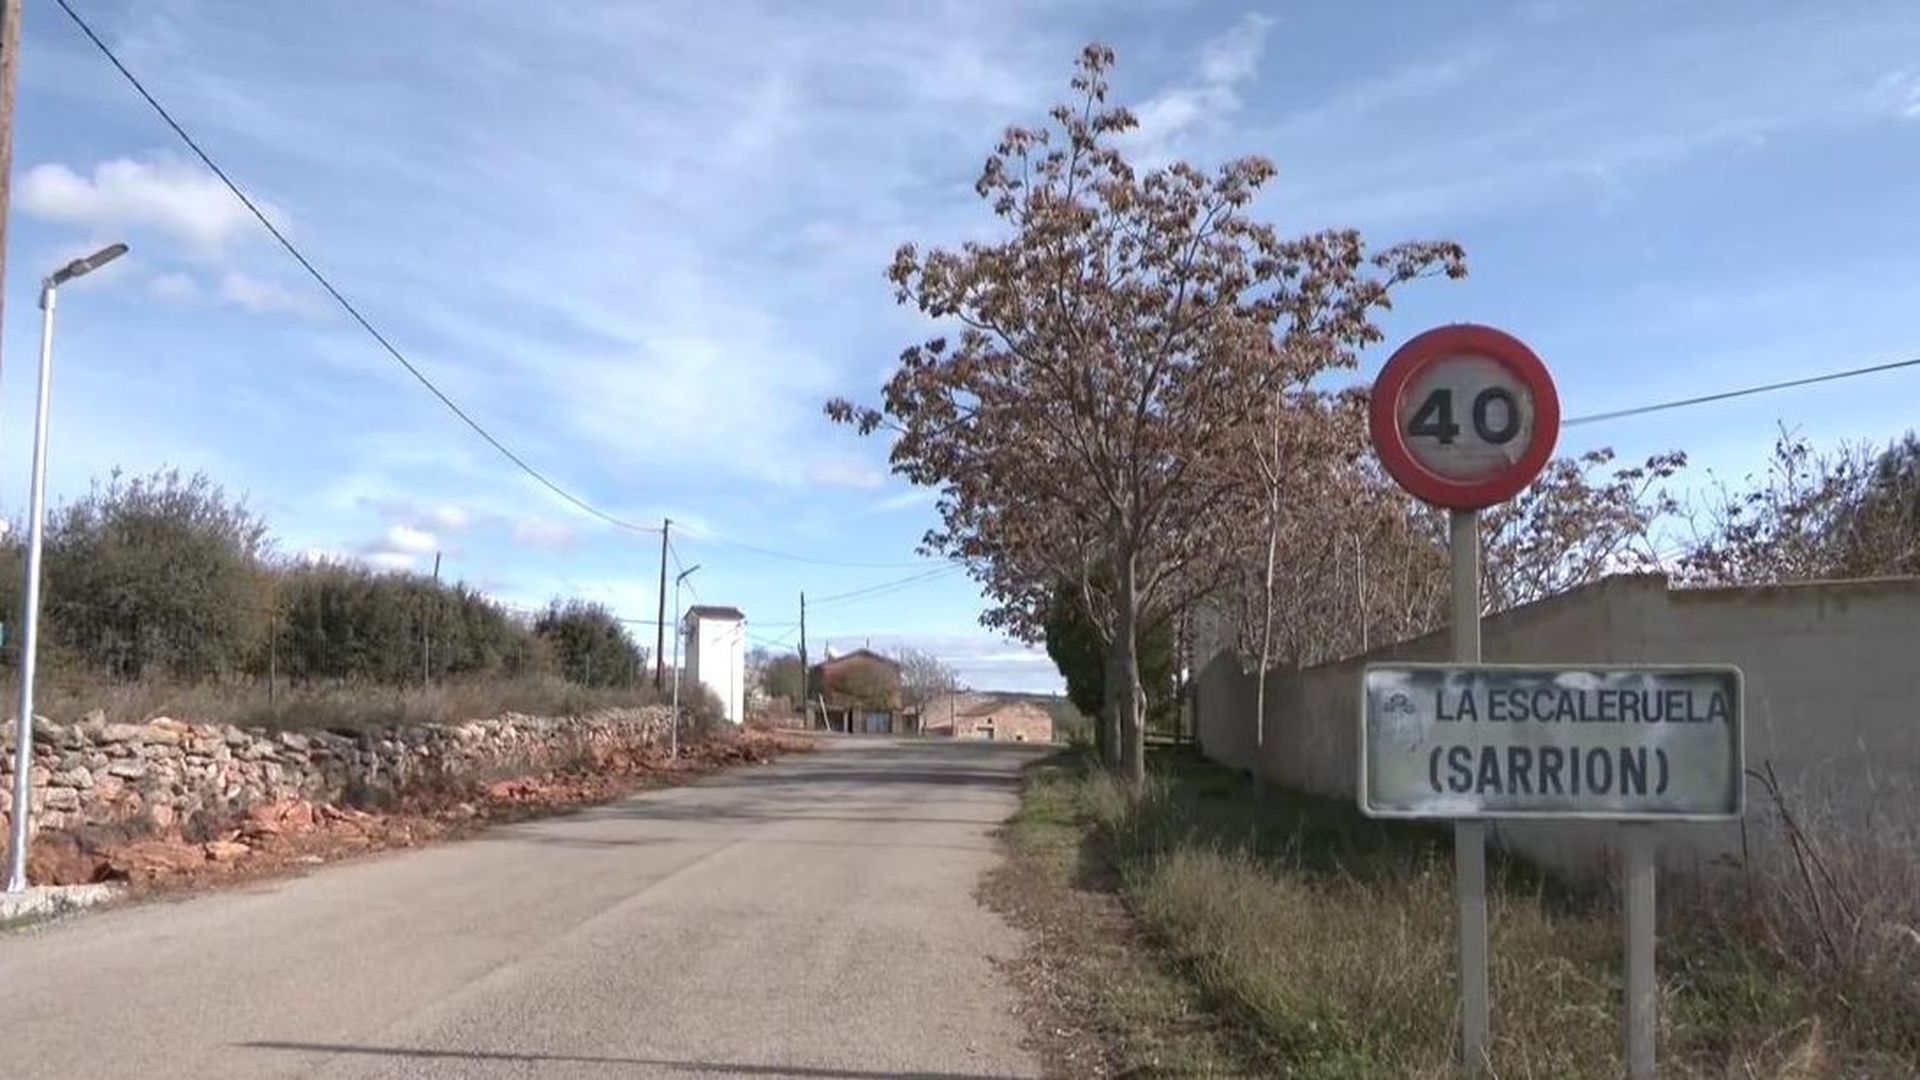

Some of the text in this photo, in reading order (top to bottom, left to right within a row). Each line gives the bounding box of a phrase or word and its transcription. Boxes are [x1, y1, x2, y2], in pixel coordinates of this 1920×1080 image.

[1408, 387, 1522, 444] 40
[1436, 689, 1730, 723] LA ESCALERUELA
[1429, 745, 1669, 797] (SARRION)
